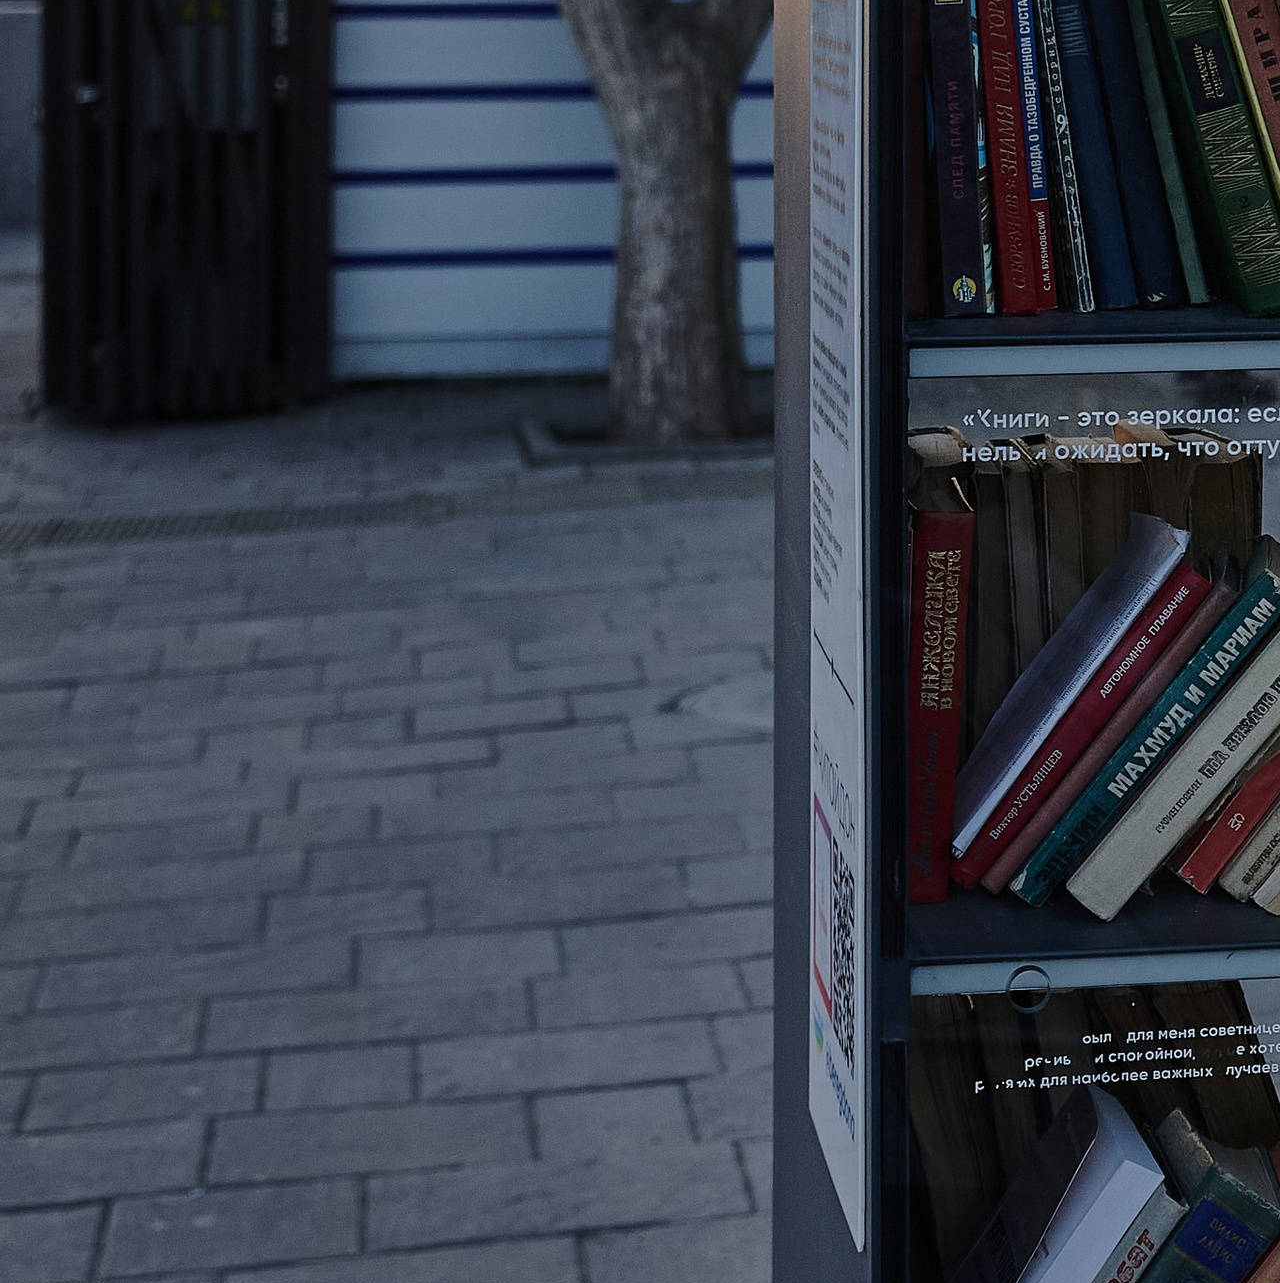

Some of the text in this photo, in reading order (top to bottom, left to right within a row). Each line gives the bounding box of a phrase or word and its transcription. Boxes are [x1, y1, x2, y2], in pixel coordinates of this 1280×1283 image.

[988, 47, 1011, 95] НАД
[1019, 36, 1039, 131] ТАЗОБЕДРЕННОМ
[947, 79, 960, 149] ПАМЯТИ
[993, 100, 1018, 178] ЗНАМЯ
[1028, 143, 1044, 188] ПРАВДА
[1035, 210, 1050, 269] БУБНОВСКИЙ
[1077, 410, 1120, 427] это
[1127, 407, 1239, 429] зеркала:
[1054, 441, 1170, 463] ожидать,
[1178, 440, 1222, 457] что
[920, 549, 949, 710] АНЖЕЛИКА
[939, 615, 957, 692] НОВОМ
[988, 585, 1190, 841] Виктор УСТЬЯНЦЕВ АВТОНОМНОЕ ПЛАВАНИЕ
[1106, 597, 1277, 799] МАХМУД И МАРИАМ
[1220, 690, 1279, 753] ЗВЕЗДОЮ
[1126, 1027, 1196, 1043] для меня
